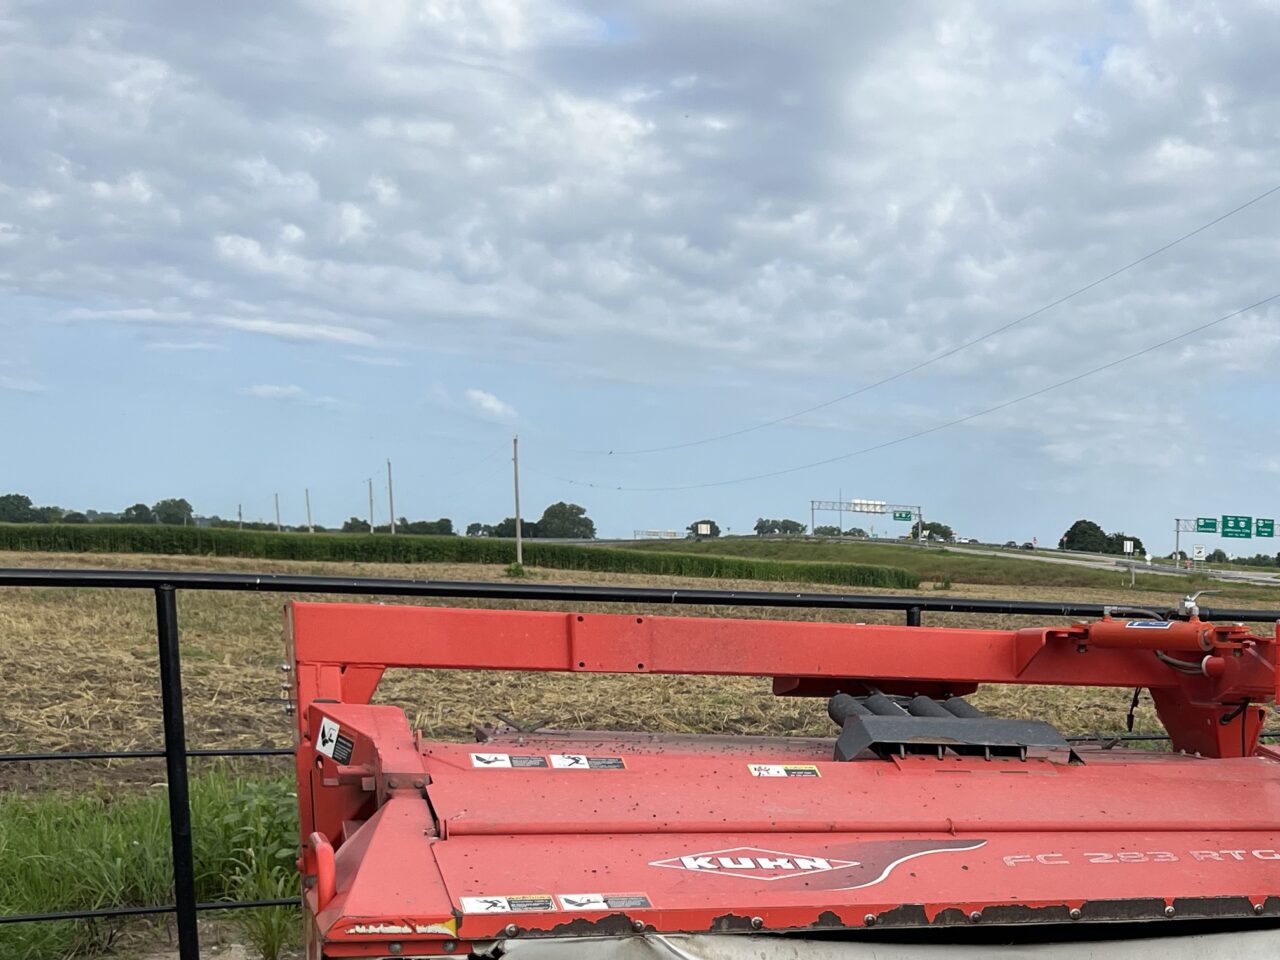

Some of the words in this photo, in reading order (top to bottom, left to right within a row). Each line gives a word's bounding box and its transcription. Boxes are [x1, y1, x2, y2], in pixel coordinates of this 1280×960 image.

[679, 856, 834, 870] KUHN
[1002, 853, 1070, 867] FC
[1083, 851, 1180, 865] 283
